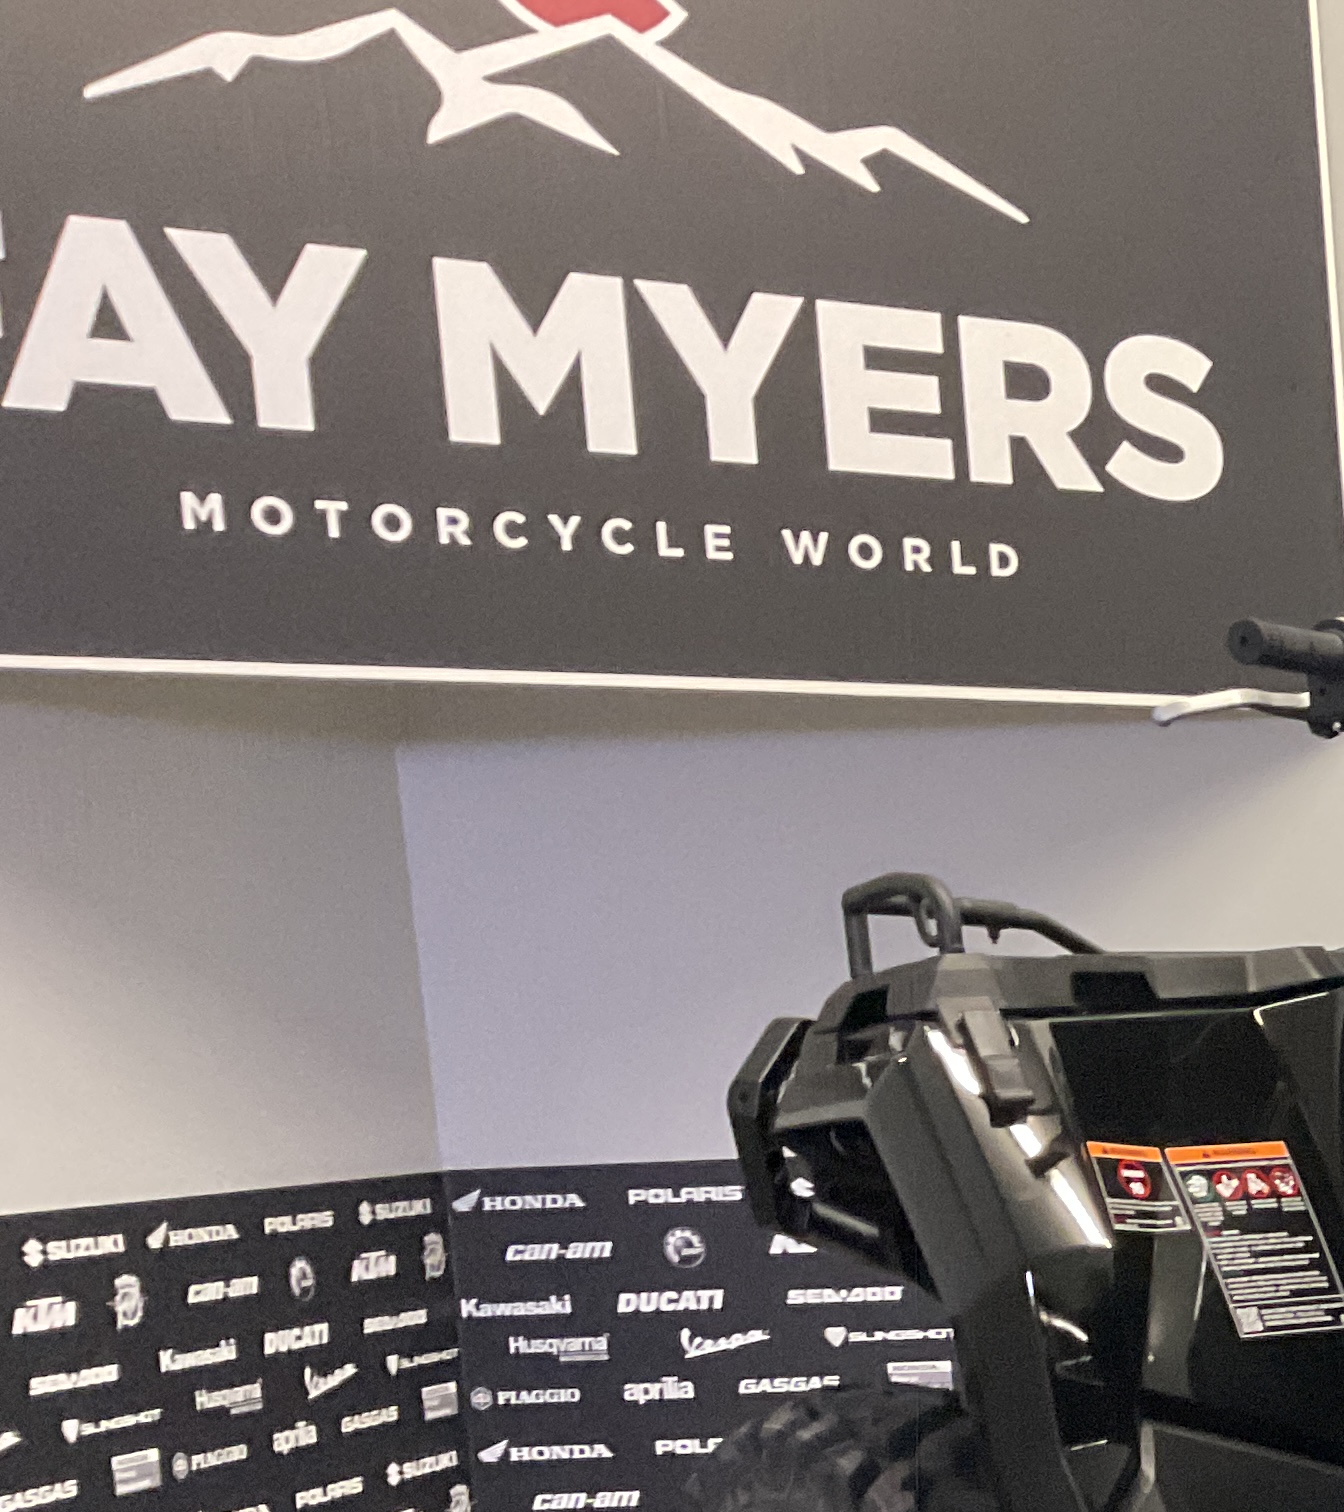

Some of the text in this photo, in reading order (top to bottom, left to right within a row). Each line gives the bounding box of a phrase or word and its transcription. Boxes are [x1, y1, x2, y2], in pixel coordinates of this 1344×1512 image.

[0, 212, 1223, 501] AY MYERS
[180, 491, 1018, 577] MOTORCYCLE WORLD
[482, 1193, 586, 1211] HONDA
[628, 1185, 745, 1205] POLARIS
[168, 1224, 240, 1246] HONDA
[46, 1234, 125, 1261] SUZUKI
[505, 1241, 613, 1261] can-am
[460, 1294, 572, 1318] Kawasaki
[617, 1289, 724, 1313] DUCATI
[497, 1388, 581, 1405] PIAGGIO
[509, 1444, 614, 1461] HONDA
[532, 1490, 640, 1510] can-am
